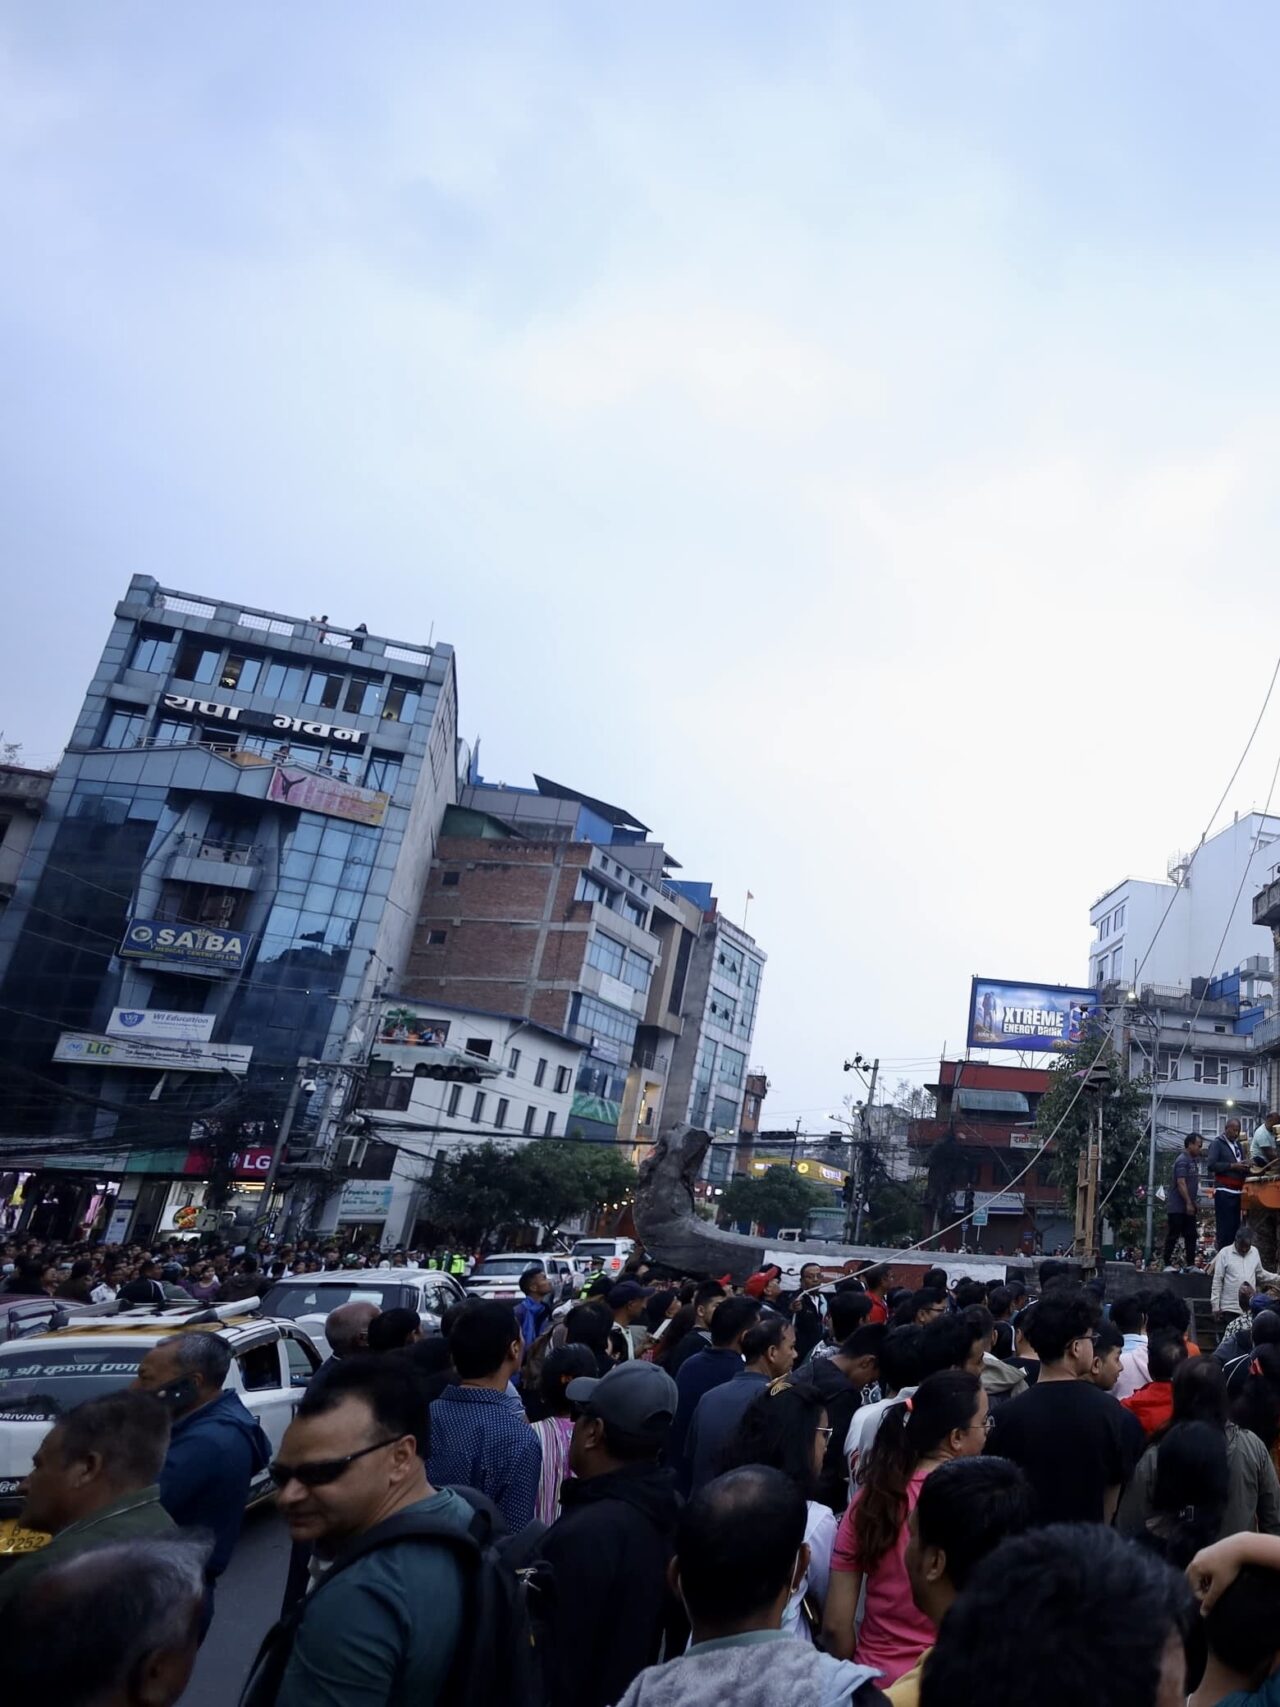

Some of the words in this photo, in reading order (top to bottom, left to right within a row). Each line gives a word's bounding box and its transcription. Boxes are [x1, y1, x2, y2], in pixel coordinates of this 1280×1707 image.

[273, 714, 366, 743] भवन
[1004, 1007, 1064, 1027] XTREME
[1003, 1023, 1035, 1036] ENERGY
[1037, 1025, 1063, 1038] DRINK
[86, 1042, 112, 1056] LIC
[243, 1154, 272, 1170] LG
[100, 1363, 141, 1373] प्रणा
